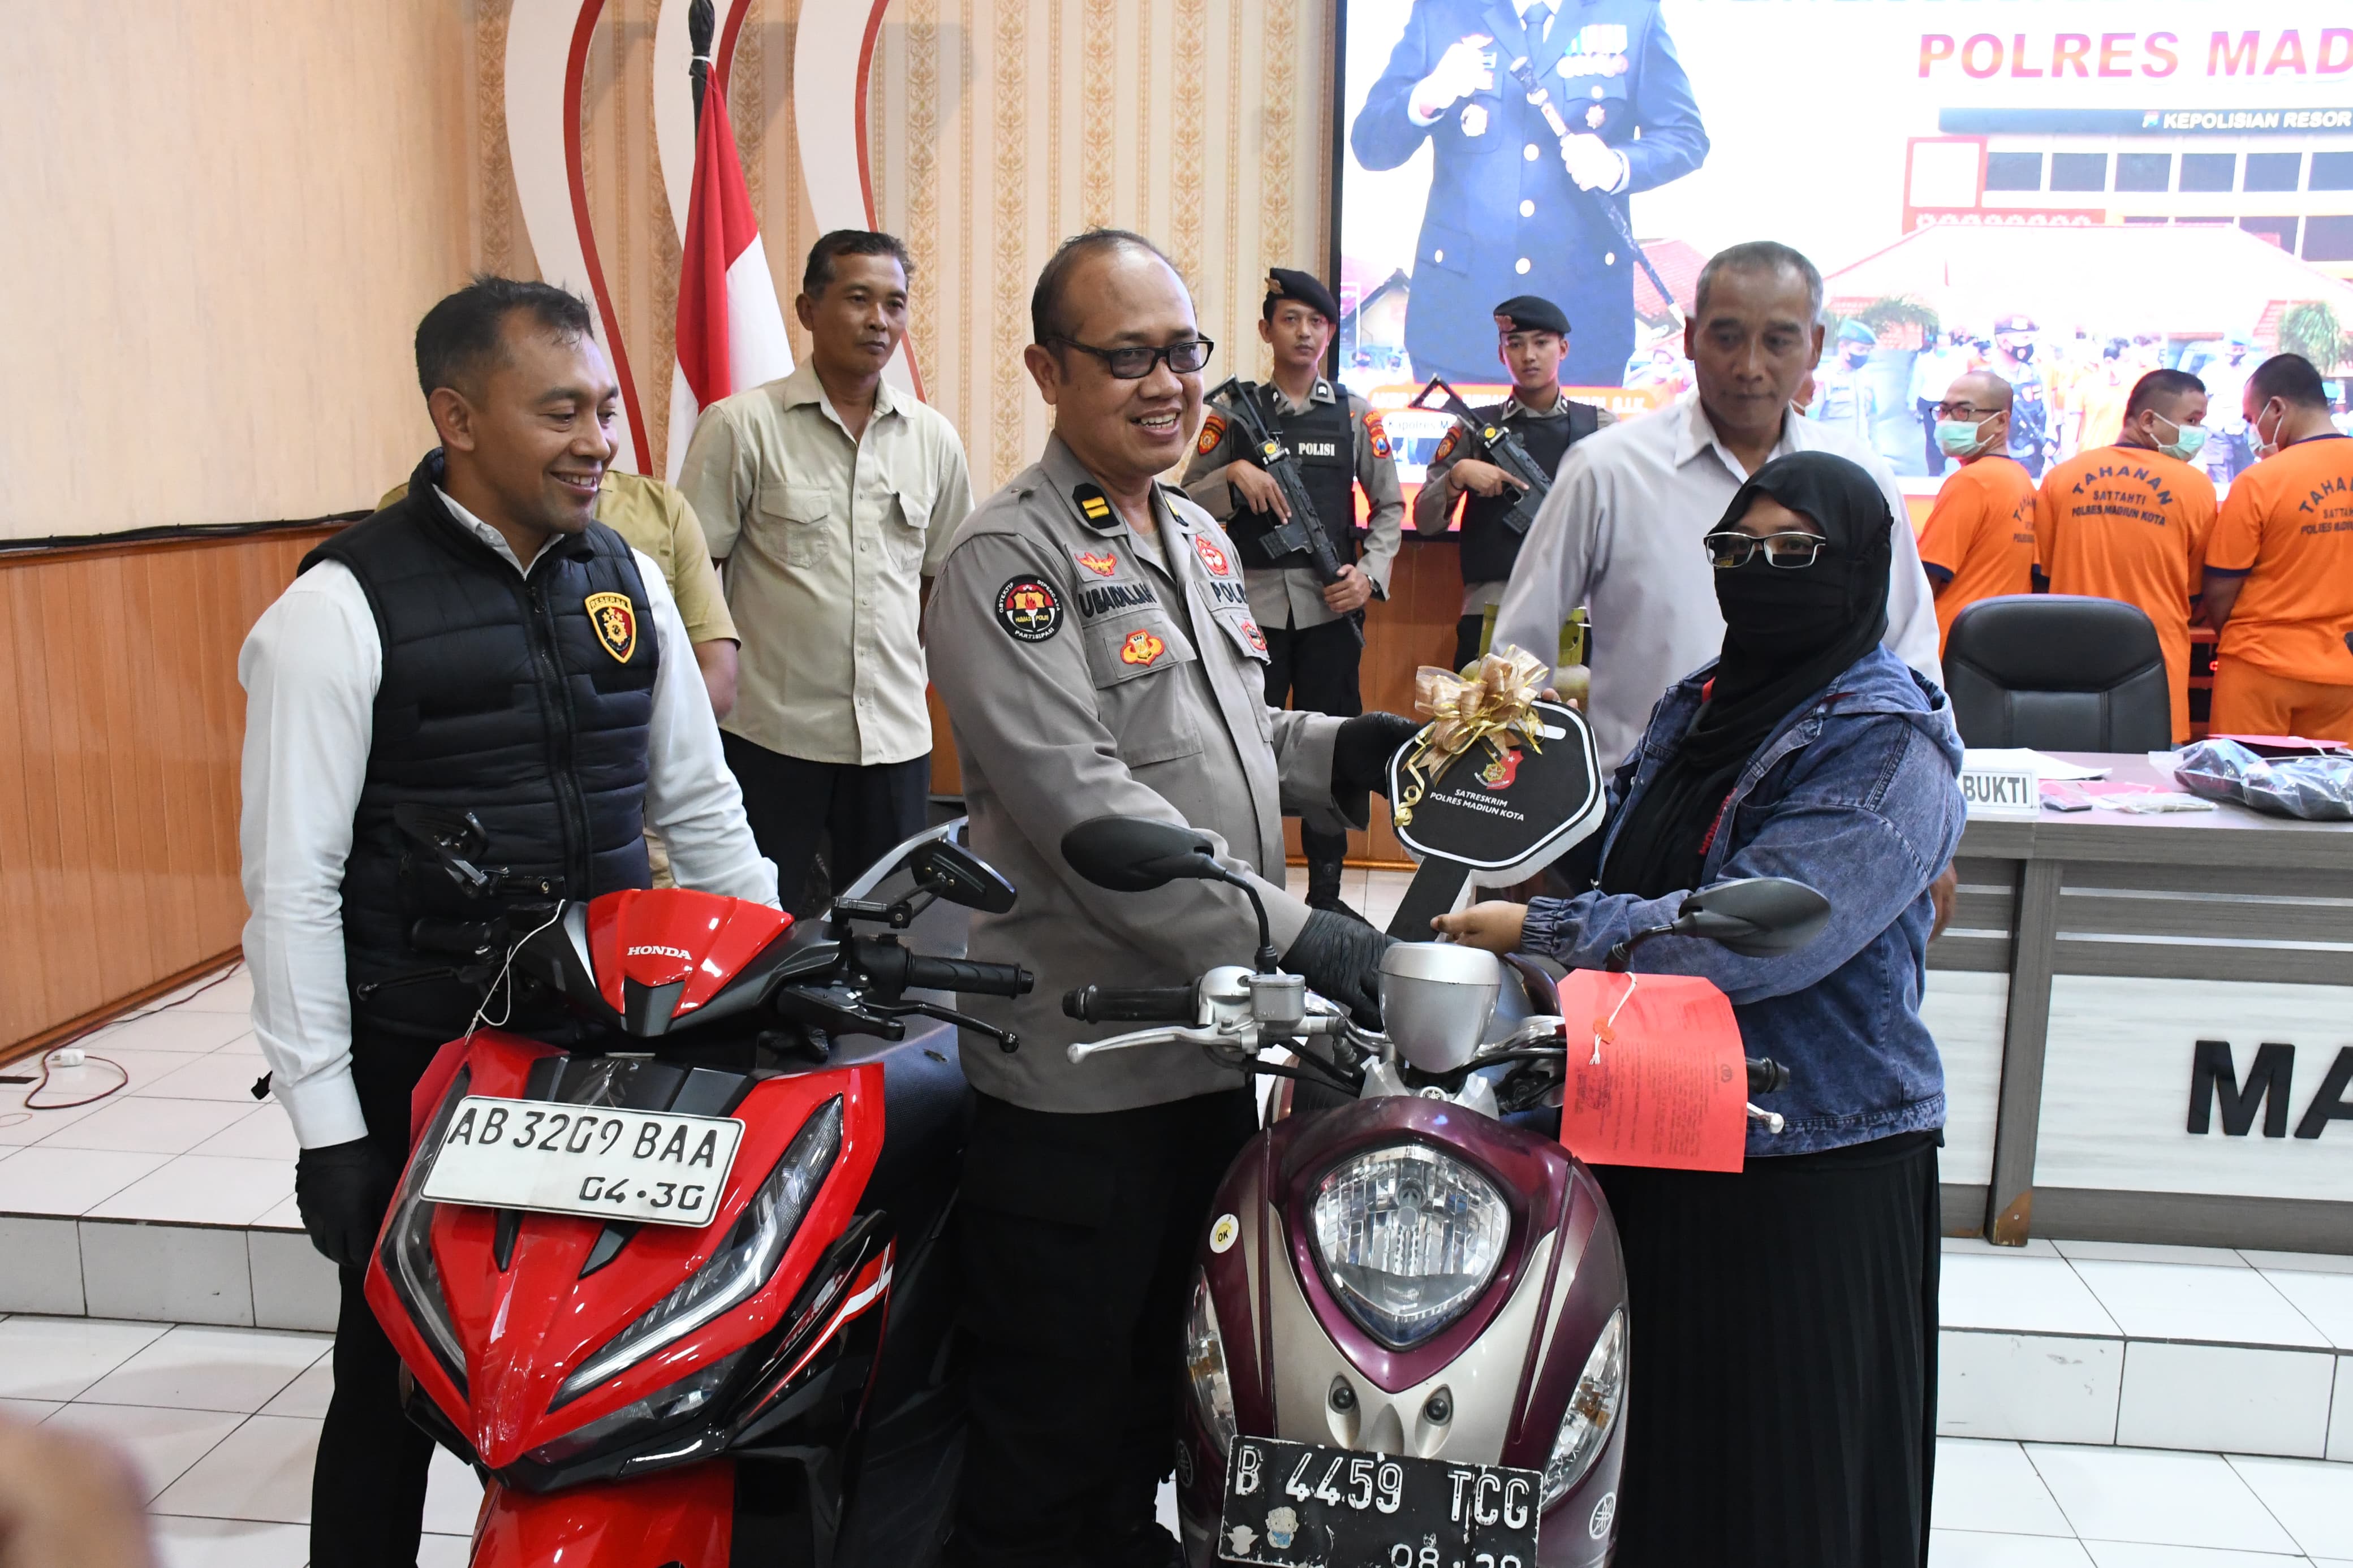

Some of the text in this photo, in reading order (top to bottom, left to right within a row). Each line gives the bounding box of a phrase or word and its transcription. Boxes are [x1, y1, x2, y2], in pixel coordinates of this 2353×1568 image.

[1918, 31, 2179, 79] POLRES
[2163, 111, 2352, 129] KEPOLISIAN RESOR
[1298, 442, 1335, 456] POLISI
[2072, 465, 2173, 506] TAHANAN
[2093, 490, 2147, 506] SATTAHTI
[2298, 477, 2353, 513] TAHA
[2072, 504, 2166, 526] POLRES MADIUN KOTA
[998, 582, 1014, 614] OBYEKTIF
[1037, 579, 1061, 611] DIPERCAYA
[1014, 627, 1055, 640] PARTISIPASI
[1454, 788, 1509, 808] SATRESKRIM
[1963, 775, 2027, 804] BUKTI
[1429, 792, 1525, 822] POLRES MADIUN KOTA
[627, 945, 692, 961] HONDA
[447, 1107, 718, 1169] AB 3209 BAA
[1218, 1229, 1229, 1242] OK
[1235, 1445, 1530, 1530] B 4459 TCG
